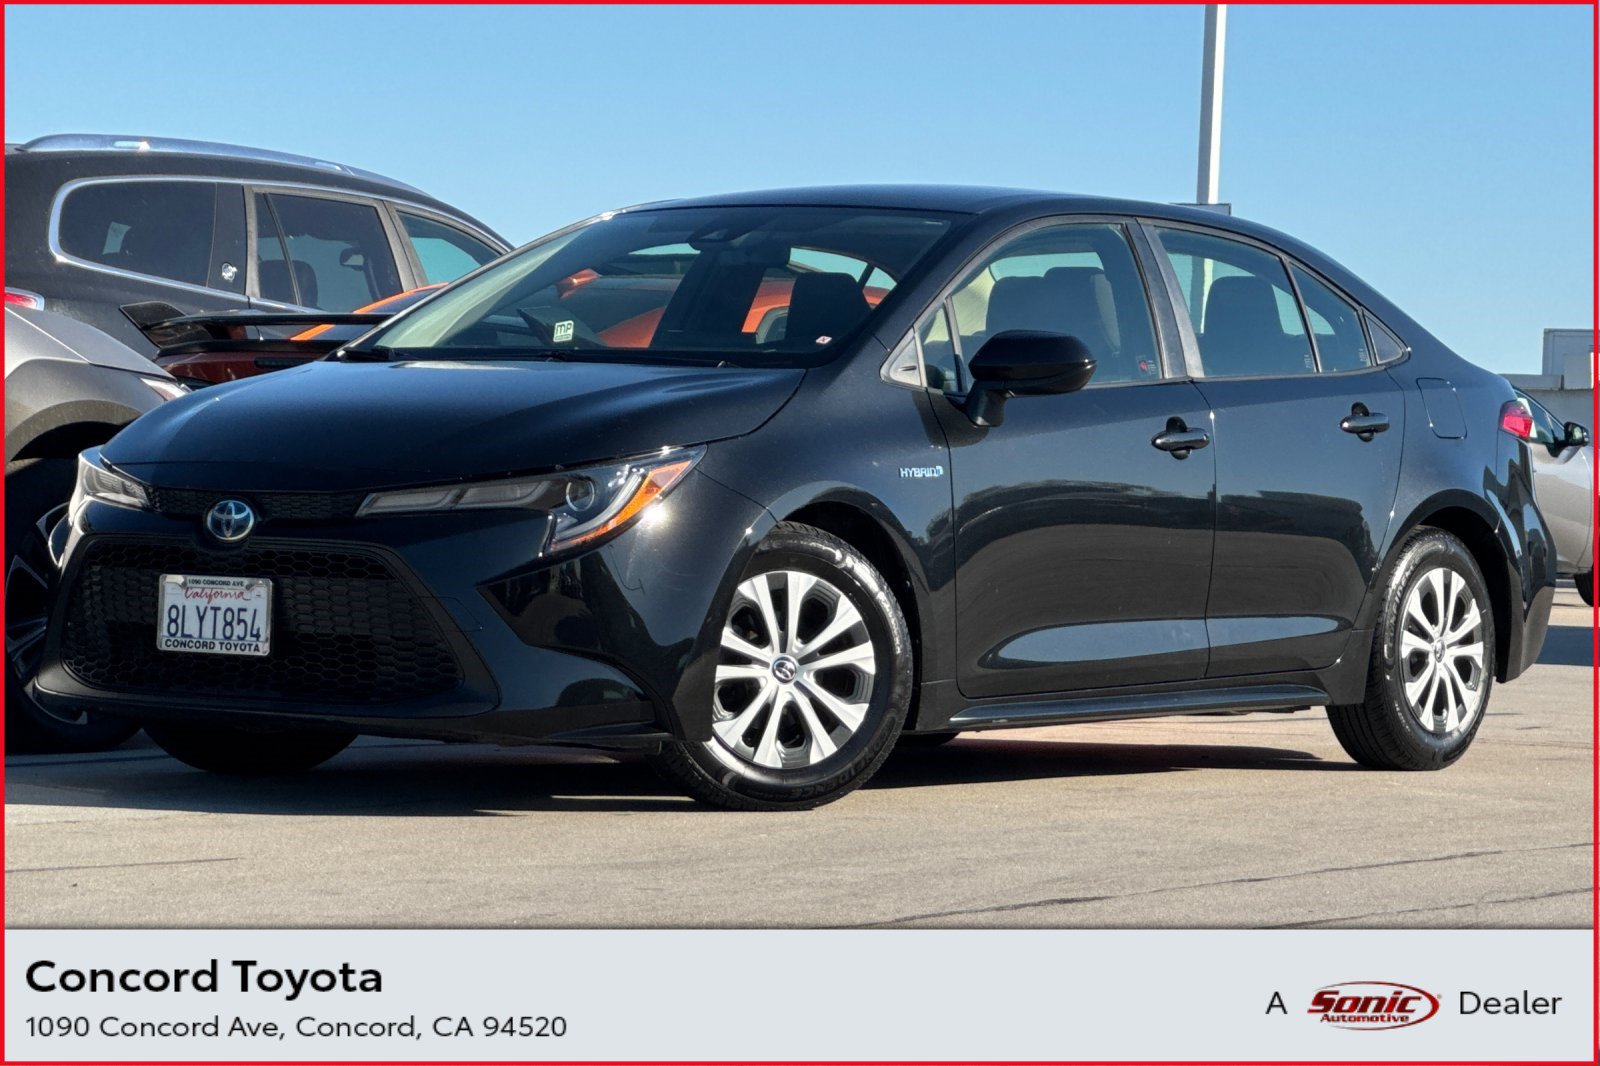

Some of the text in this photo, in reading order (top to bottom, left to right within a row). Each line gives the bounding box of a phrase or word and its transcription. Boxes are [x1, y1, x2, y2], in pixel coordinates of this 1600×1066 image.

[899, 466, 938, 478] HYBRID
[185, 587, 251, 604] California
[167, 604, 261, 641] 8LYT854
[165, 639, 260, 653] CONCORD TOYOTA
